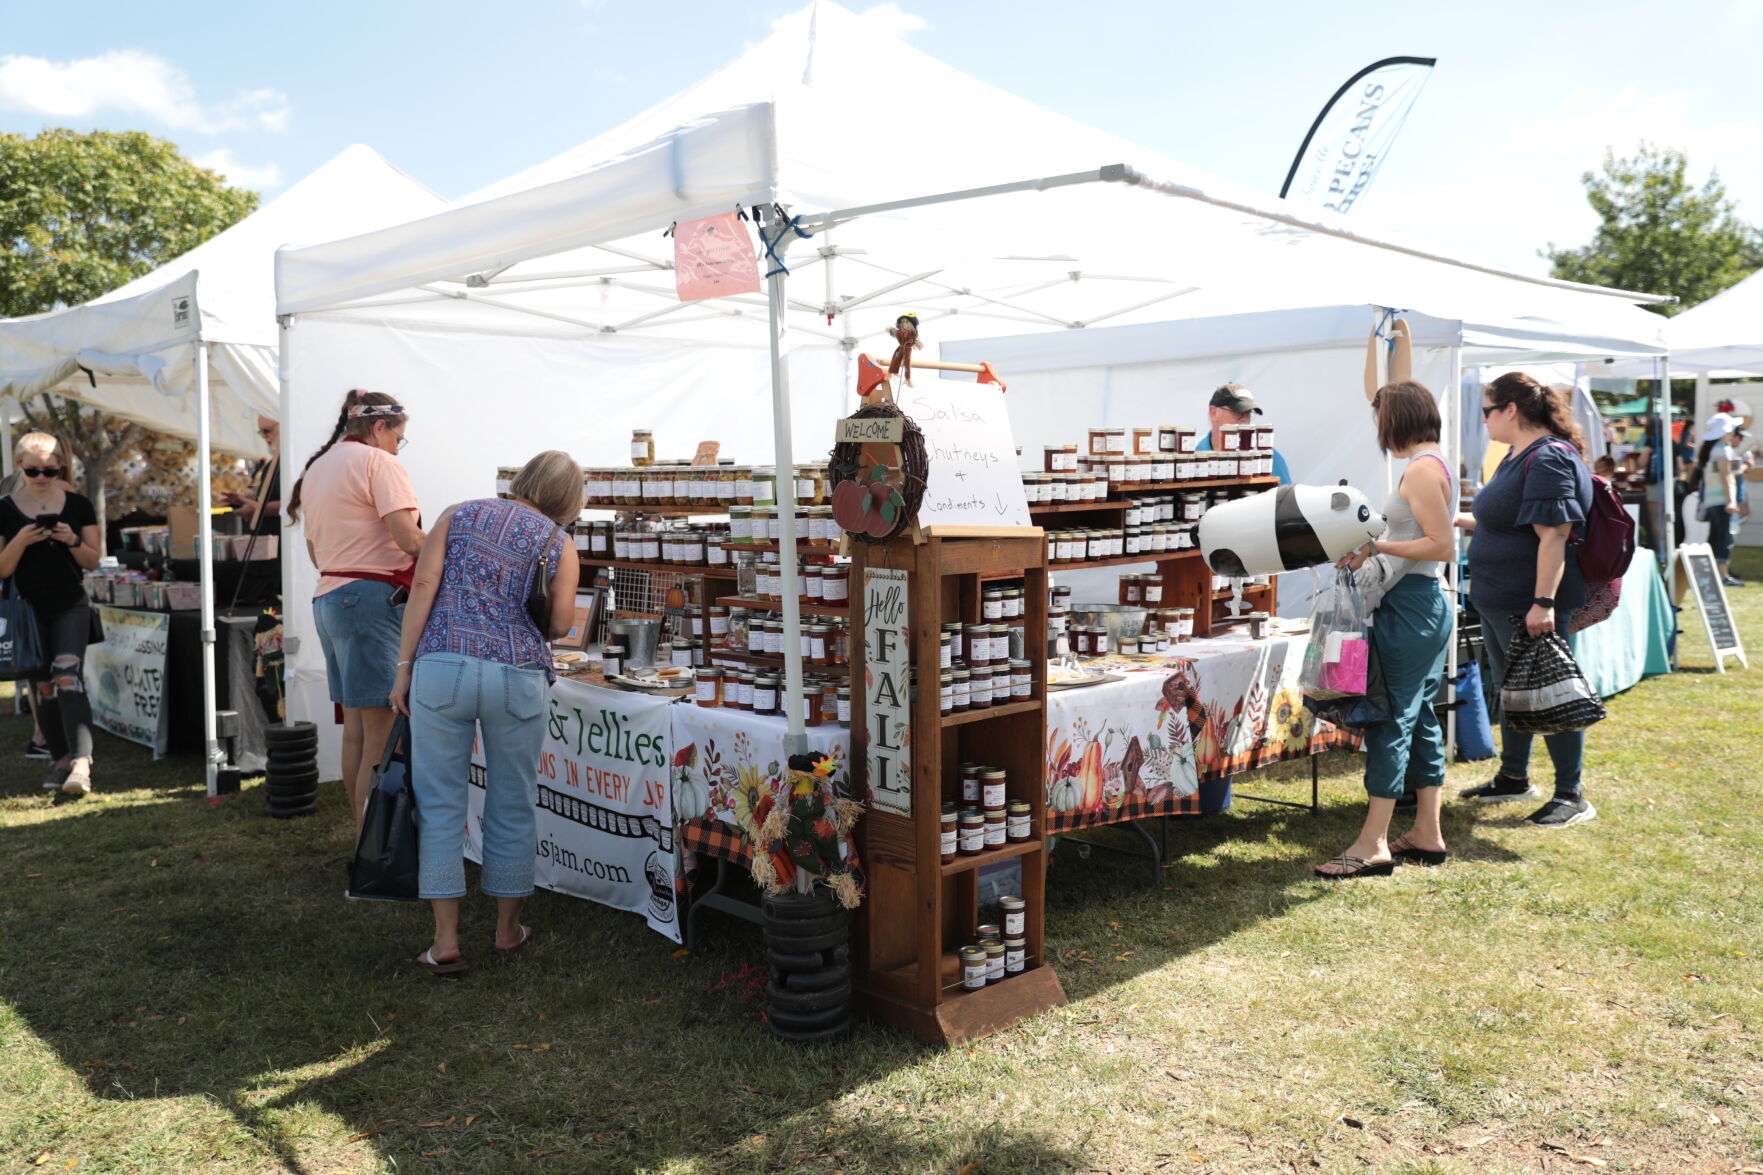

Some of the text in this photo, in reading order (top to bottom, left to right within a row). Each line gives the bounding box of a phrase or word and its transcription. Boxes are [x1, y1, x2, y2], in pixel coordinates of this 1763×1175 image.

[1328, 83, 1385, 194] PECANS
[844, 420, 891, 440] WELCOME
[913, 397, 986, 423] Salsa
[923, 490, 986, 512] Condiments
[864, 586, 905, 627] Hello
[873, 627, 902, 794] FALL
[548, 699, 666, 768] & Jellies
[564, 758, 579, 789] IN
[586, 766, 631, 805] EVERY
